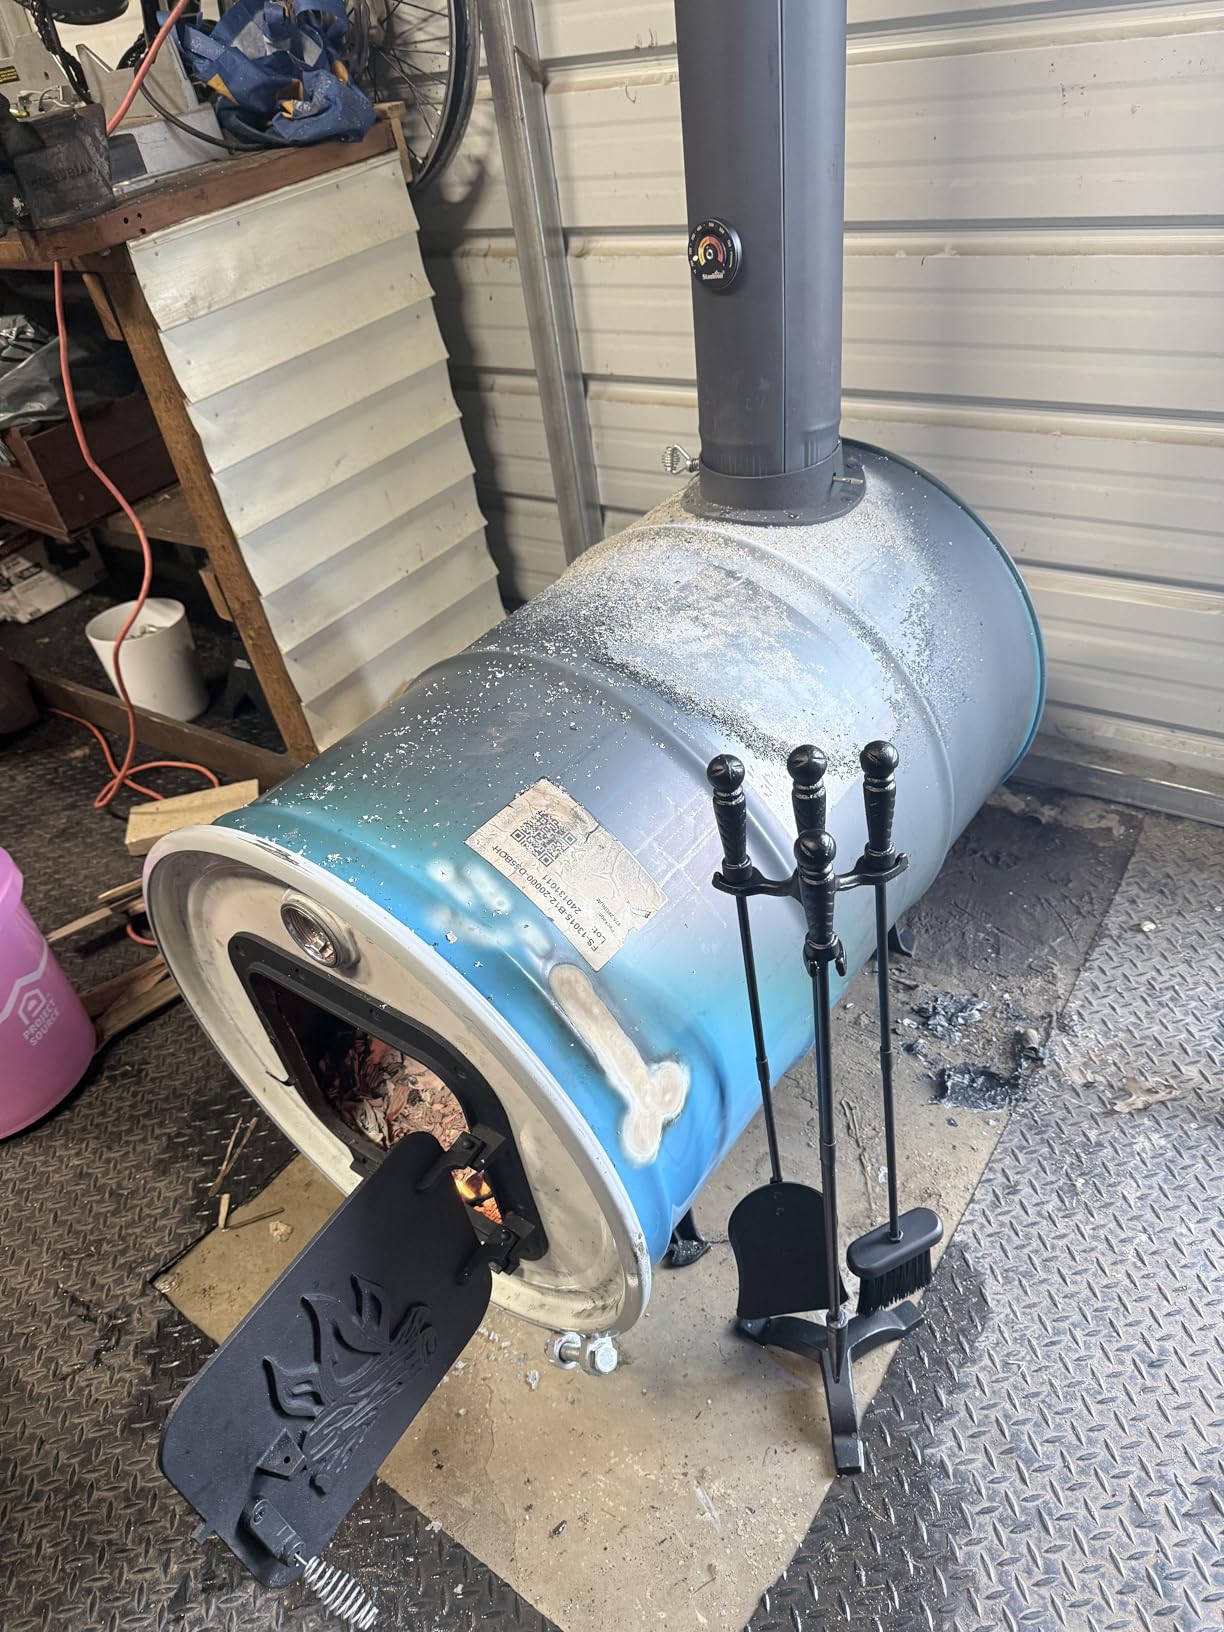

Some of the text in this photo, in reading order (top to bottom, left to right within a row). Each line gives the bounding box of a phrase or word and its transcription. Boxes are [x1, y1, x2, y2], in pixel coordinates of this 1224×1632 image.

[542, 875, 607, 945] Lot: 240131011
[23, 998, 56, 1040] PROJECT
[29, 1009, 60, 1046] SOURCE
